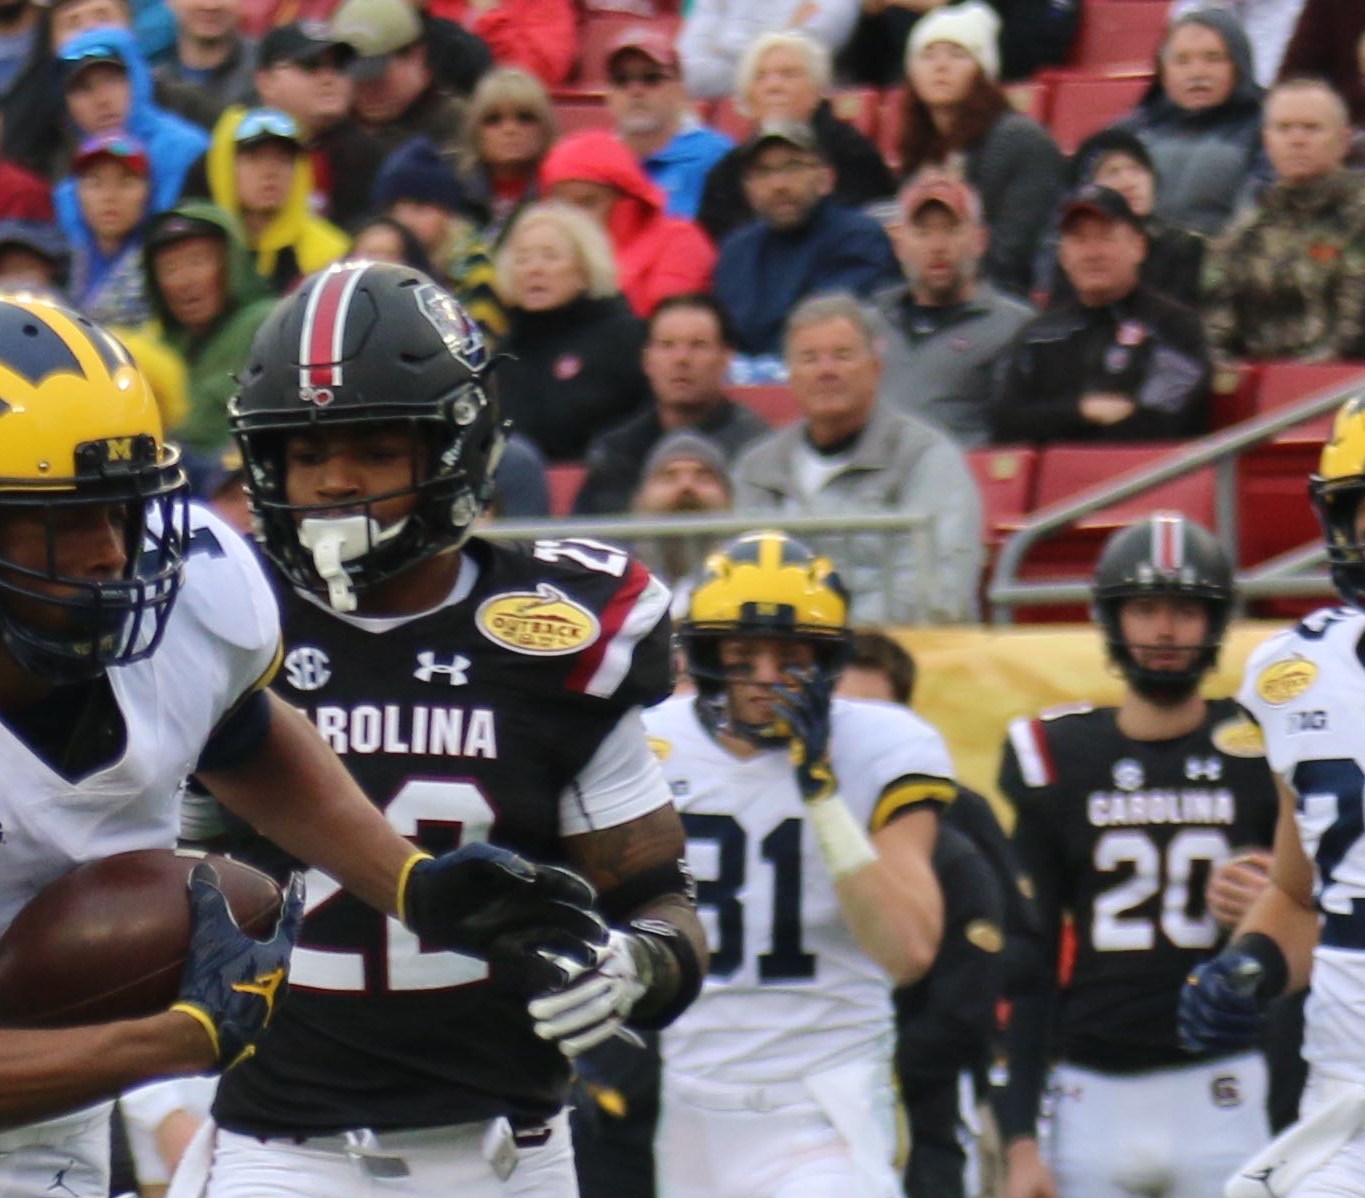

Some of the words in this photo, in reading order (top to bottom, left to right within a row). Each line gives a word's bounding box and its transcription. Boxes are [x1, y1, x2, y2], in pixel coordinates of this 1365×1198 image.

[492, 616, 582, 636] OUTBACK
[284, 646, 332, 691] SEC
[298, 703, 498, 760] ROLINA
[1092, 827, 1232, 952] 20
